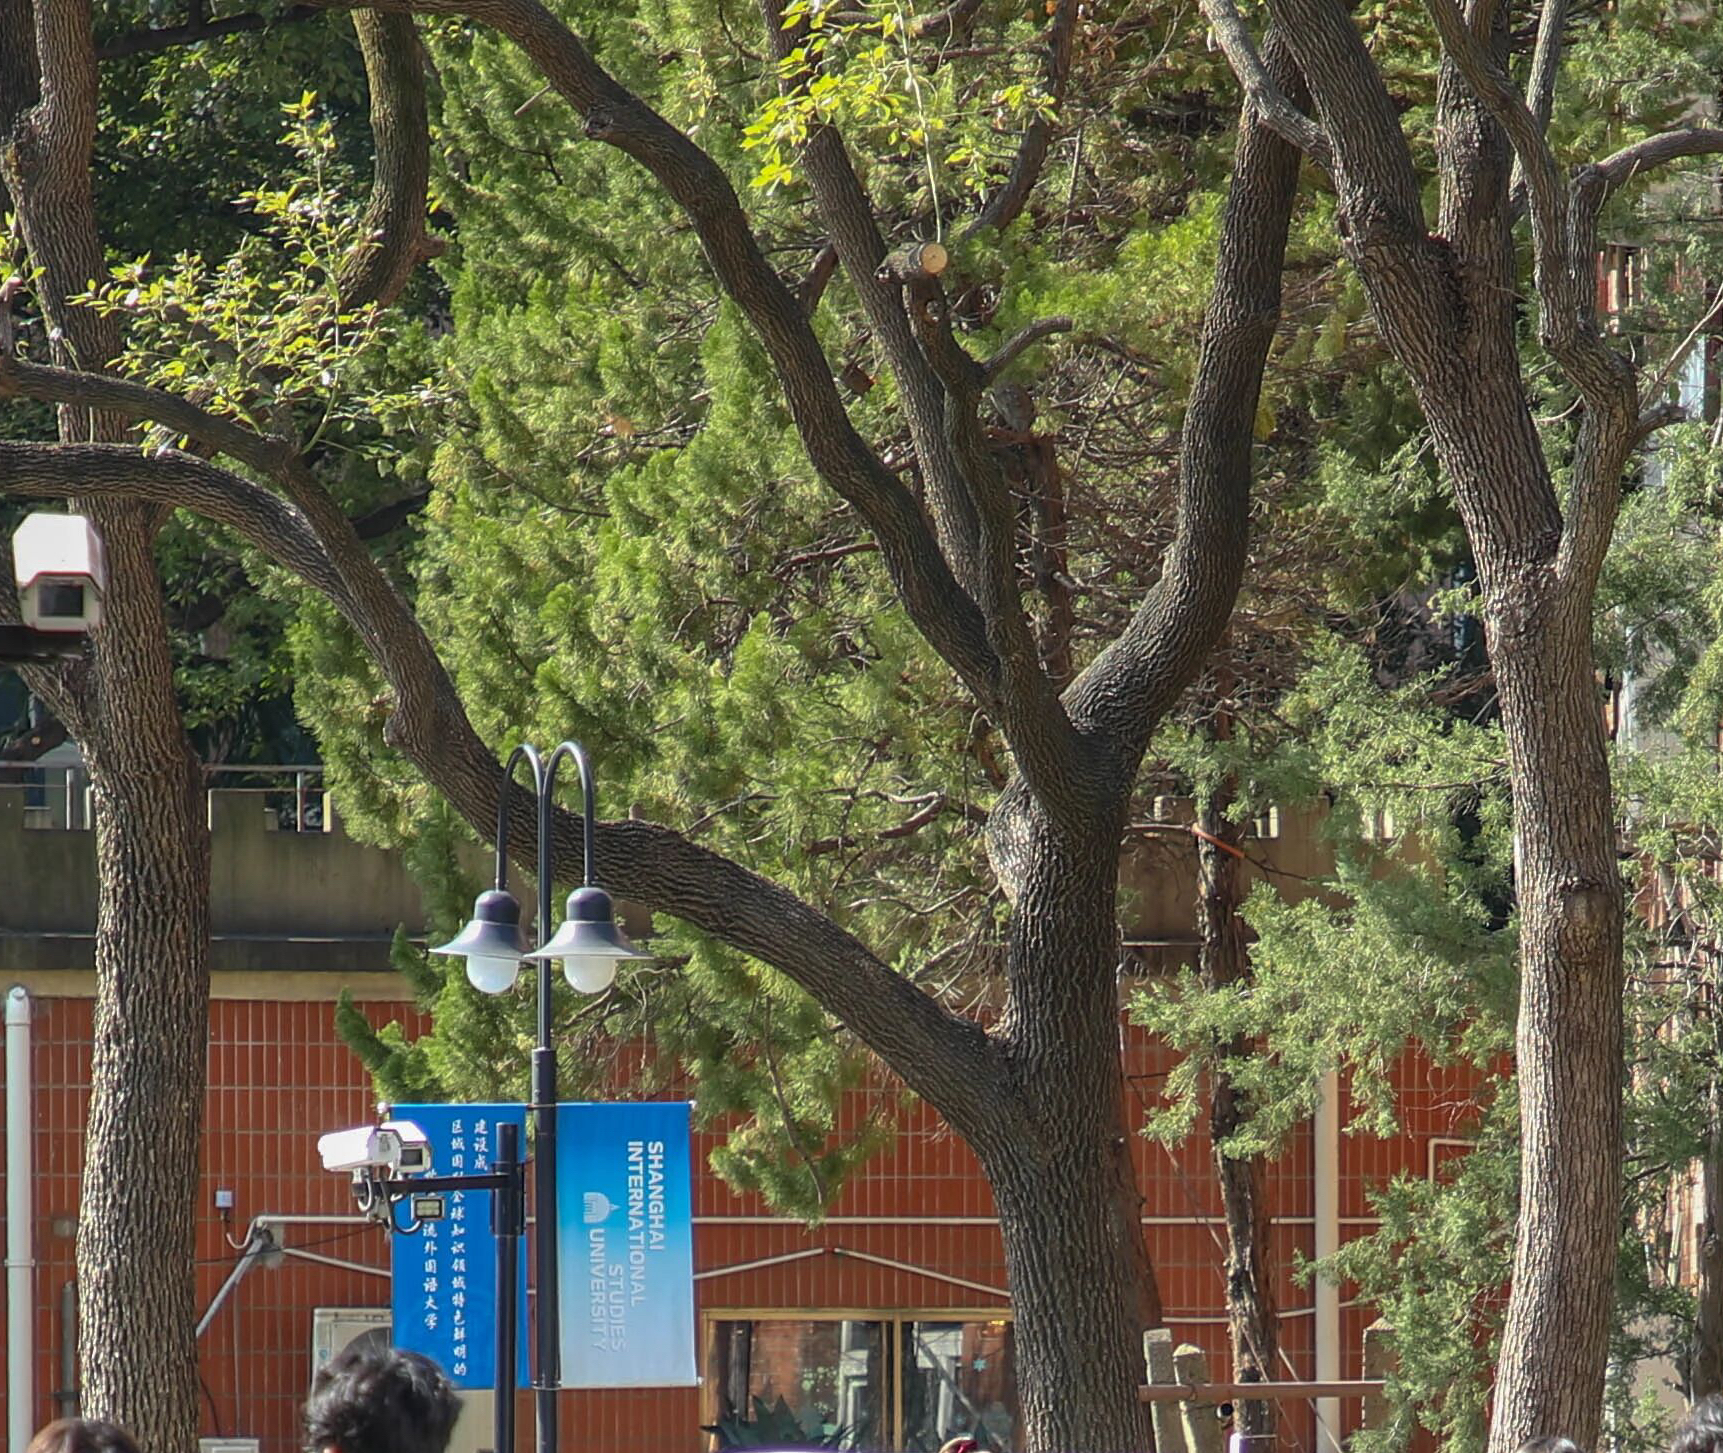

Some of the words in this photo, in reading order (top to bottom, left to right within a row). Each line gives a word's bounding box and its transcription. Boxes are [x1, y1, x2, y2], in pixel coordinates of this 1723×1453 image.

[473, 1119, 489, 1171] 建设成
[648, 1141, 665, 1250] SHANGHAI
[627, 1141, 645, 1307] INTERNATIONAL
[589, 1228, 608, 1352] UNIVERSITY
[608, 1263, 626, 1351] STUDIES
